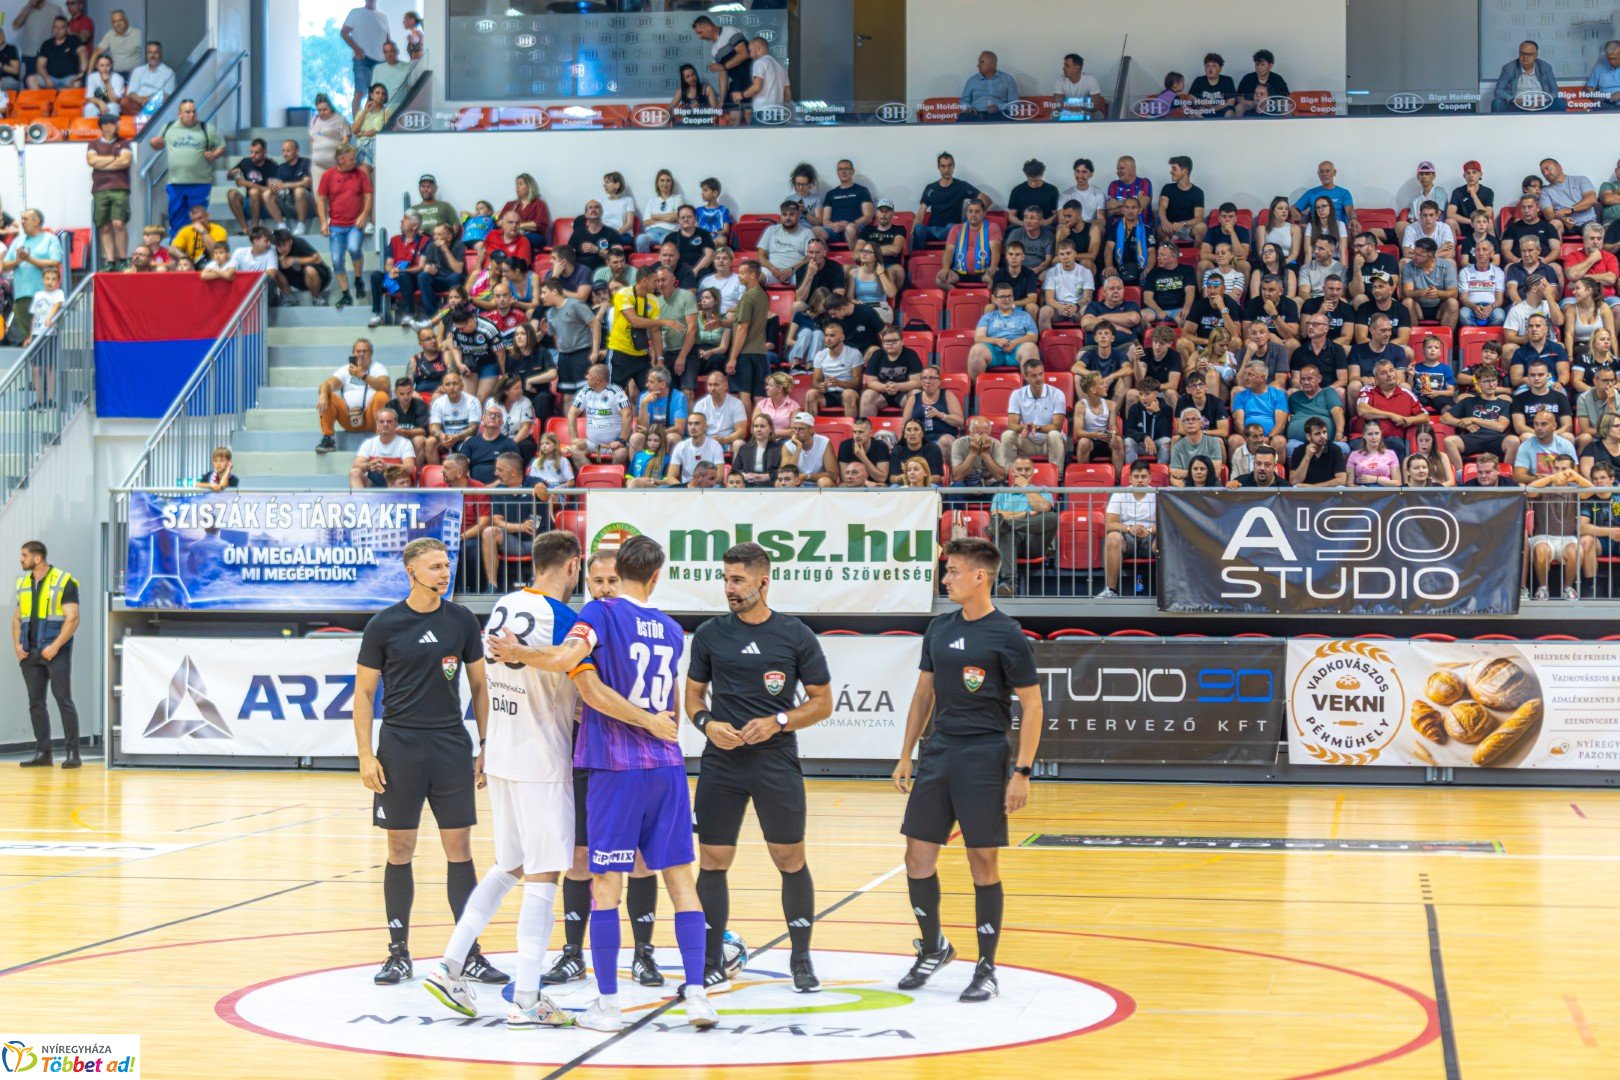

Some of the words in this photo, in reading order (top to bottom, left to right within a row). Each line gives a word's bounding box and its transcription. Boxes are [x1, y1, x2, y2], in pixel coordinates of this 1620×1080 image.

[1428, 93, 1447, 101] Bige
[1449, 92, 1481, 101] Holding
[1558, 91, 1576, 99] Bige
[1578, 91, 1611, 99] Holding
[1174, 98, 1192, 106] Bige
[1194, 97, 1225, 106] Holding
[1300, 96, 1319, 104] Bige
[1567, 100, 1601, 108] Csoport
[917, 103, 935, 111] Bige
[936, 103, 967, 111] Holding
[1043, 101, 1060, 109] Bige
[1310, 105, 1342, 113] Csoport
[1438, 102, 1472, 110] Csoport
[674, 108, 692, 116] Bige
[694, 108, 723, 116] Holding
[1183, 107, 1216, 115] Csoport
[683, 116, 714, 125] Csoport
[805, 114, 836, 122] Csoport
[926, 112, 958, 120] Csoport
[163, 497, 261, 529] SZISZÁK
[265, 497, 293, 529] ÉS
[298, 497, 373, 529] TÁRSA
[379, 502, 426, 529] KFT.
[1221, 506, 1460, 562] A'90
[669, 523, 933, 563] mlsz.hu
[252, 544, 380, 567] MEGÁLMODJA,
[241, 567, 261, 581] MI
[264, 565, 357, 581] MEGÉPÍTJÜK!
[669, 567, 724, 582] Magya
[772, 566, 834, 582] darúgó
[842, 566, 933, 582] Szövetség
[1220, 566, 1460, 600] STUDIO
[628, 642, 674, 711] 23
[1307, 658, 1389, 693] VADKOVÁSZOS
[1011, 667, 1187, 702] TUDIO
[1198, 668, 1274, 703] 90
[237, 674, 384, 720] ARZ
[834, 684, 895, 712] ÁZA
[1312, 694, 1385, 712] VEKNI
[1011, 716, 1196, 732] ÉZTERVEZŐ
[1218, 719, 1267, 732] KFT
[1306, 716, 1389, 748] PÉKMŰHELY
[1576, 740, 1620, 748] NYÍREGY
[1579, 751, 1620, 759] PAZONY
